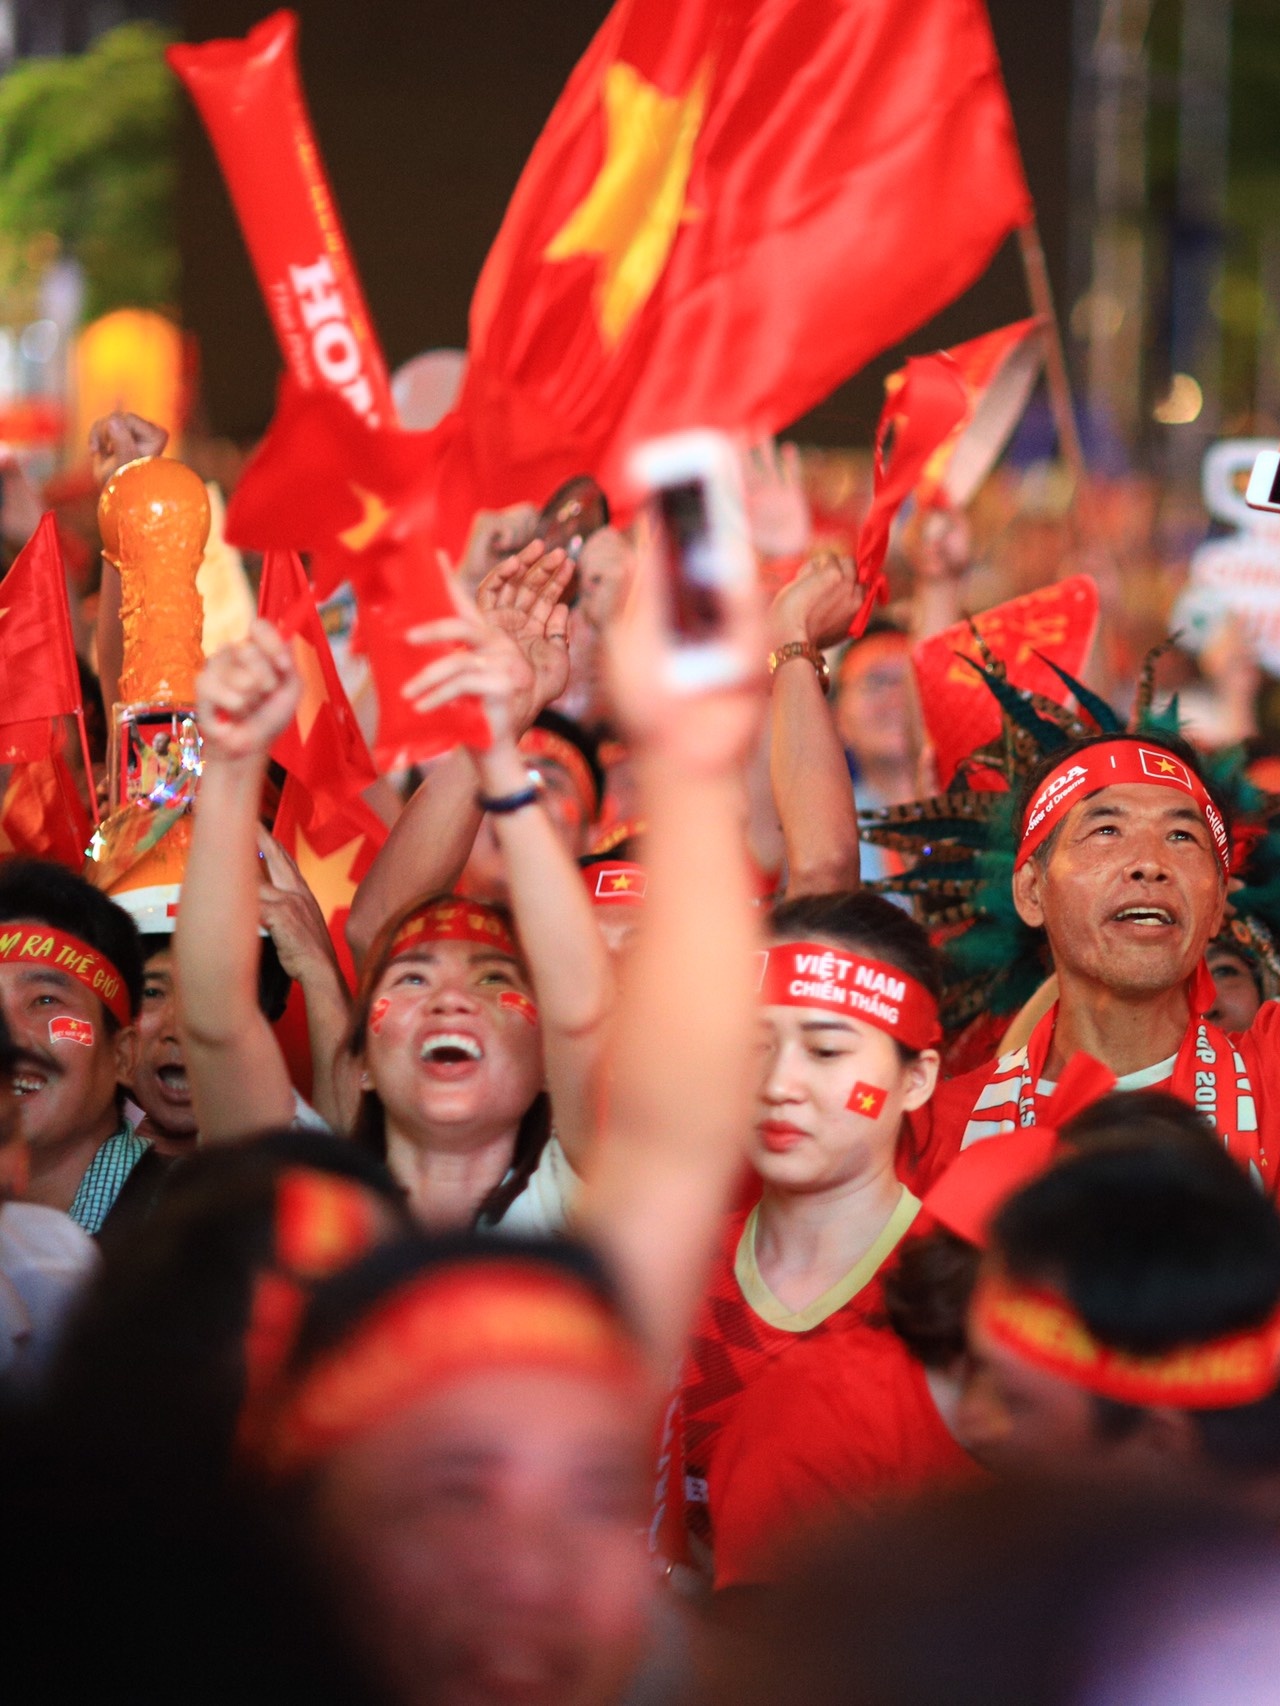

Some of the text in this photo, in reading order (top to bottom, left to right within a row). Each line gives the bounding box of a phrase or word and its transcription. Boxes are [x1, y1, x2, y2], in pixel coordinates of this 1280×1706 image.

[1029, 766, 1088, 820] NDA
[19, 935, 55, 957] RA
[789, 978, 846, 1004] CHIẾN
[794, 951, 906, 1002] VIỆT NAM
